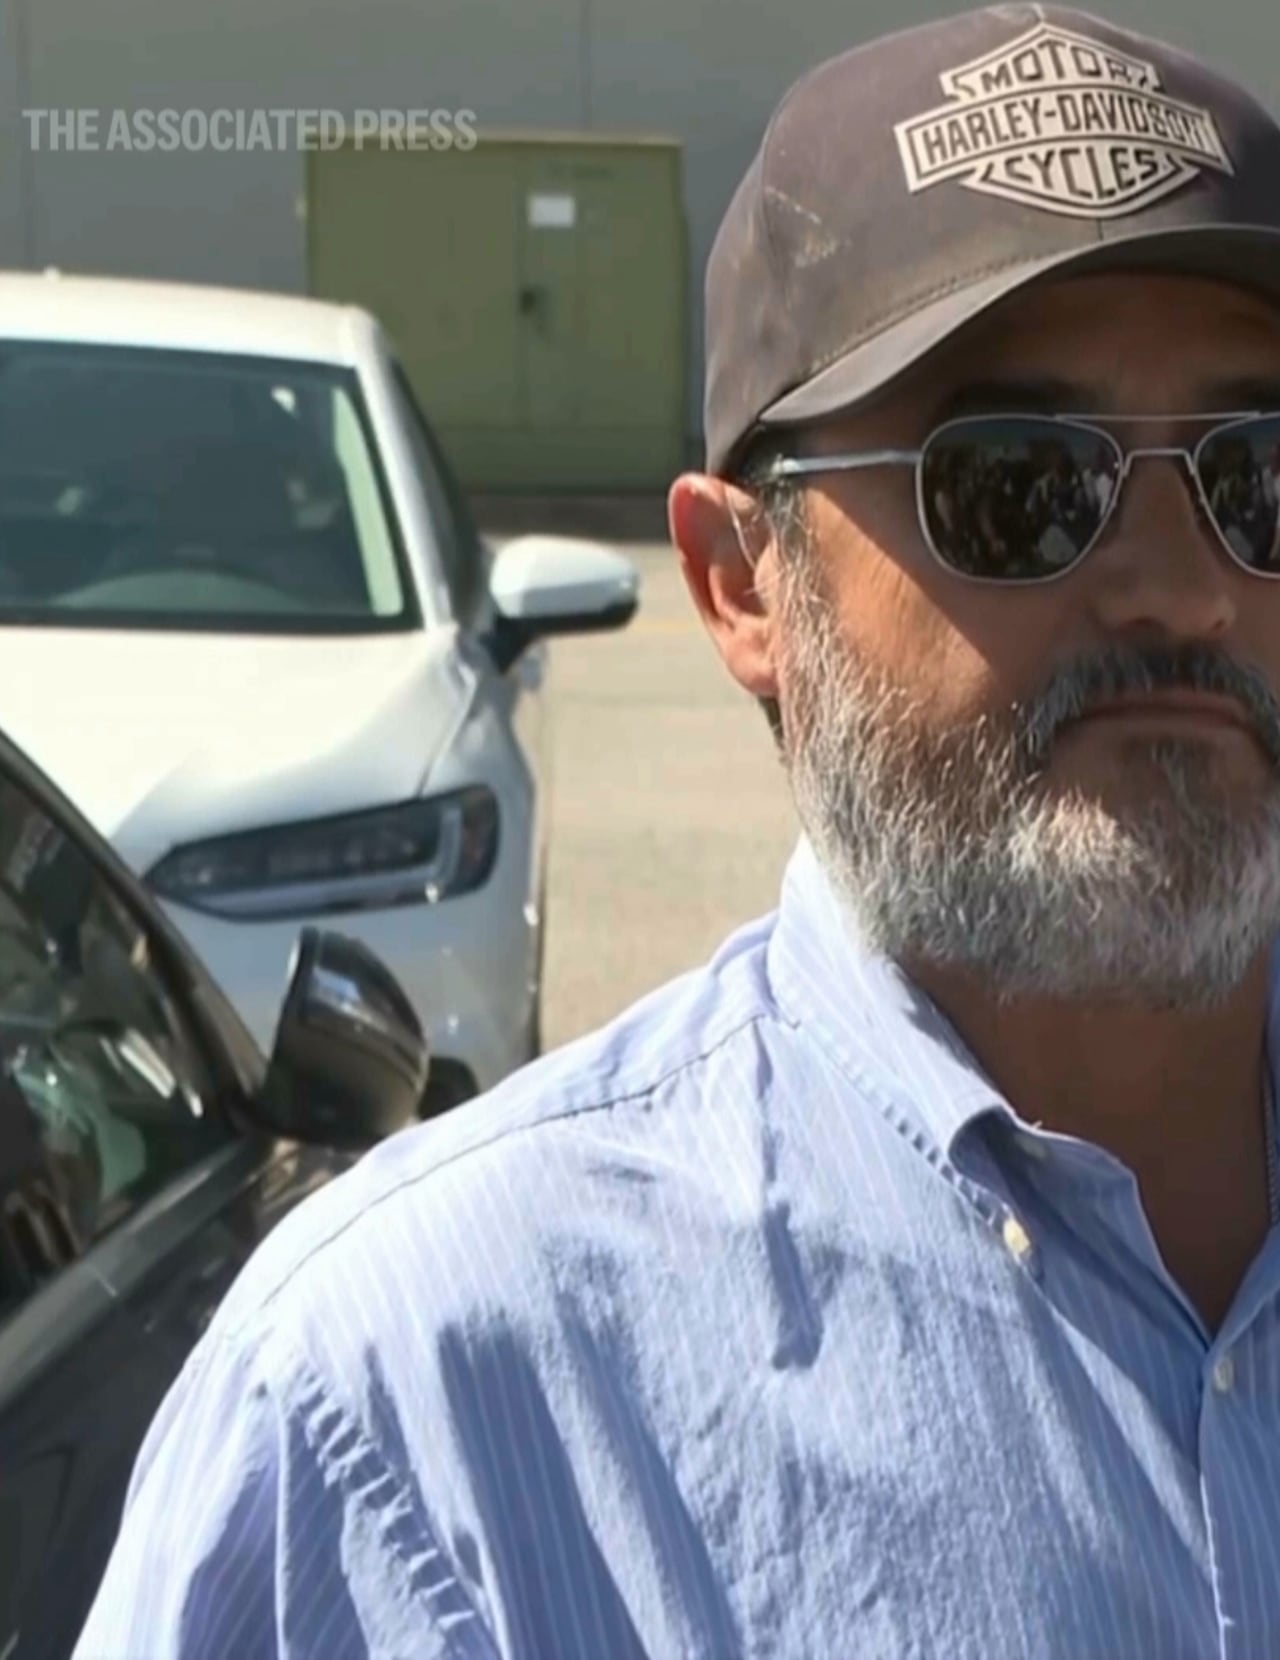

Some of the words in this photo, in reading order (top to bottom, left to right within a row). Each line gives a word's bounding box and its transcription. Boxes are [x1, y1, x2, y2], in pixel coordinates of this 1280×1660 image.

[980, 38, 1131, 92] MOTOR
[921, 92, 1207, 166] HARLEY-DAVIDSON
[1004, 147, 1155, 200] CYCLES
